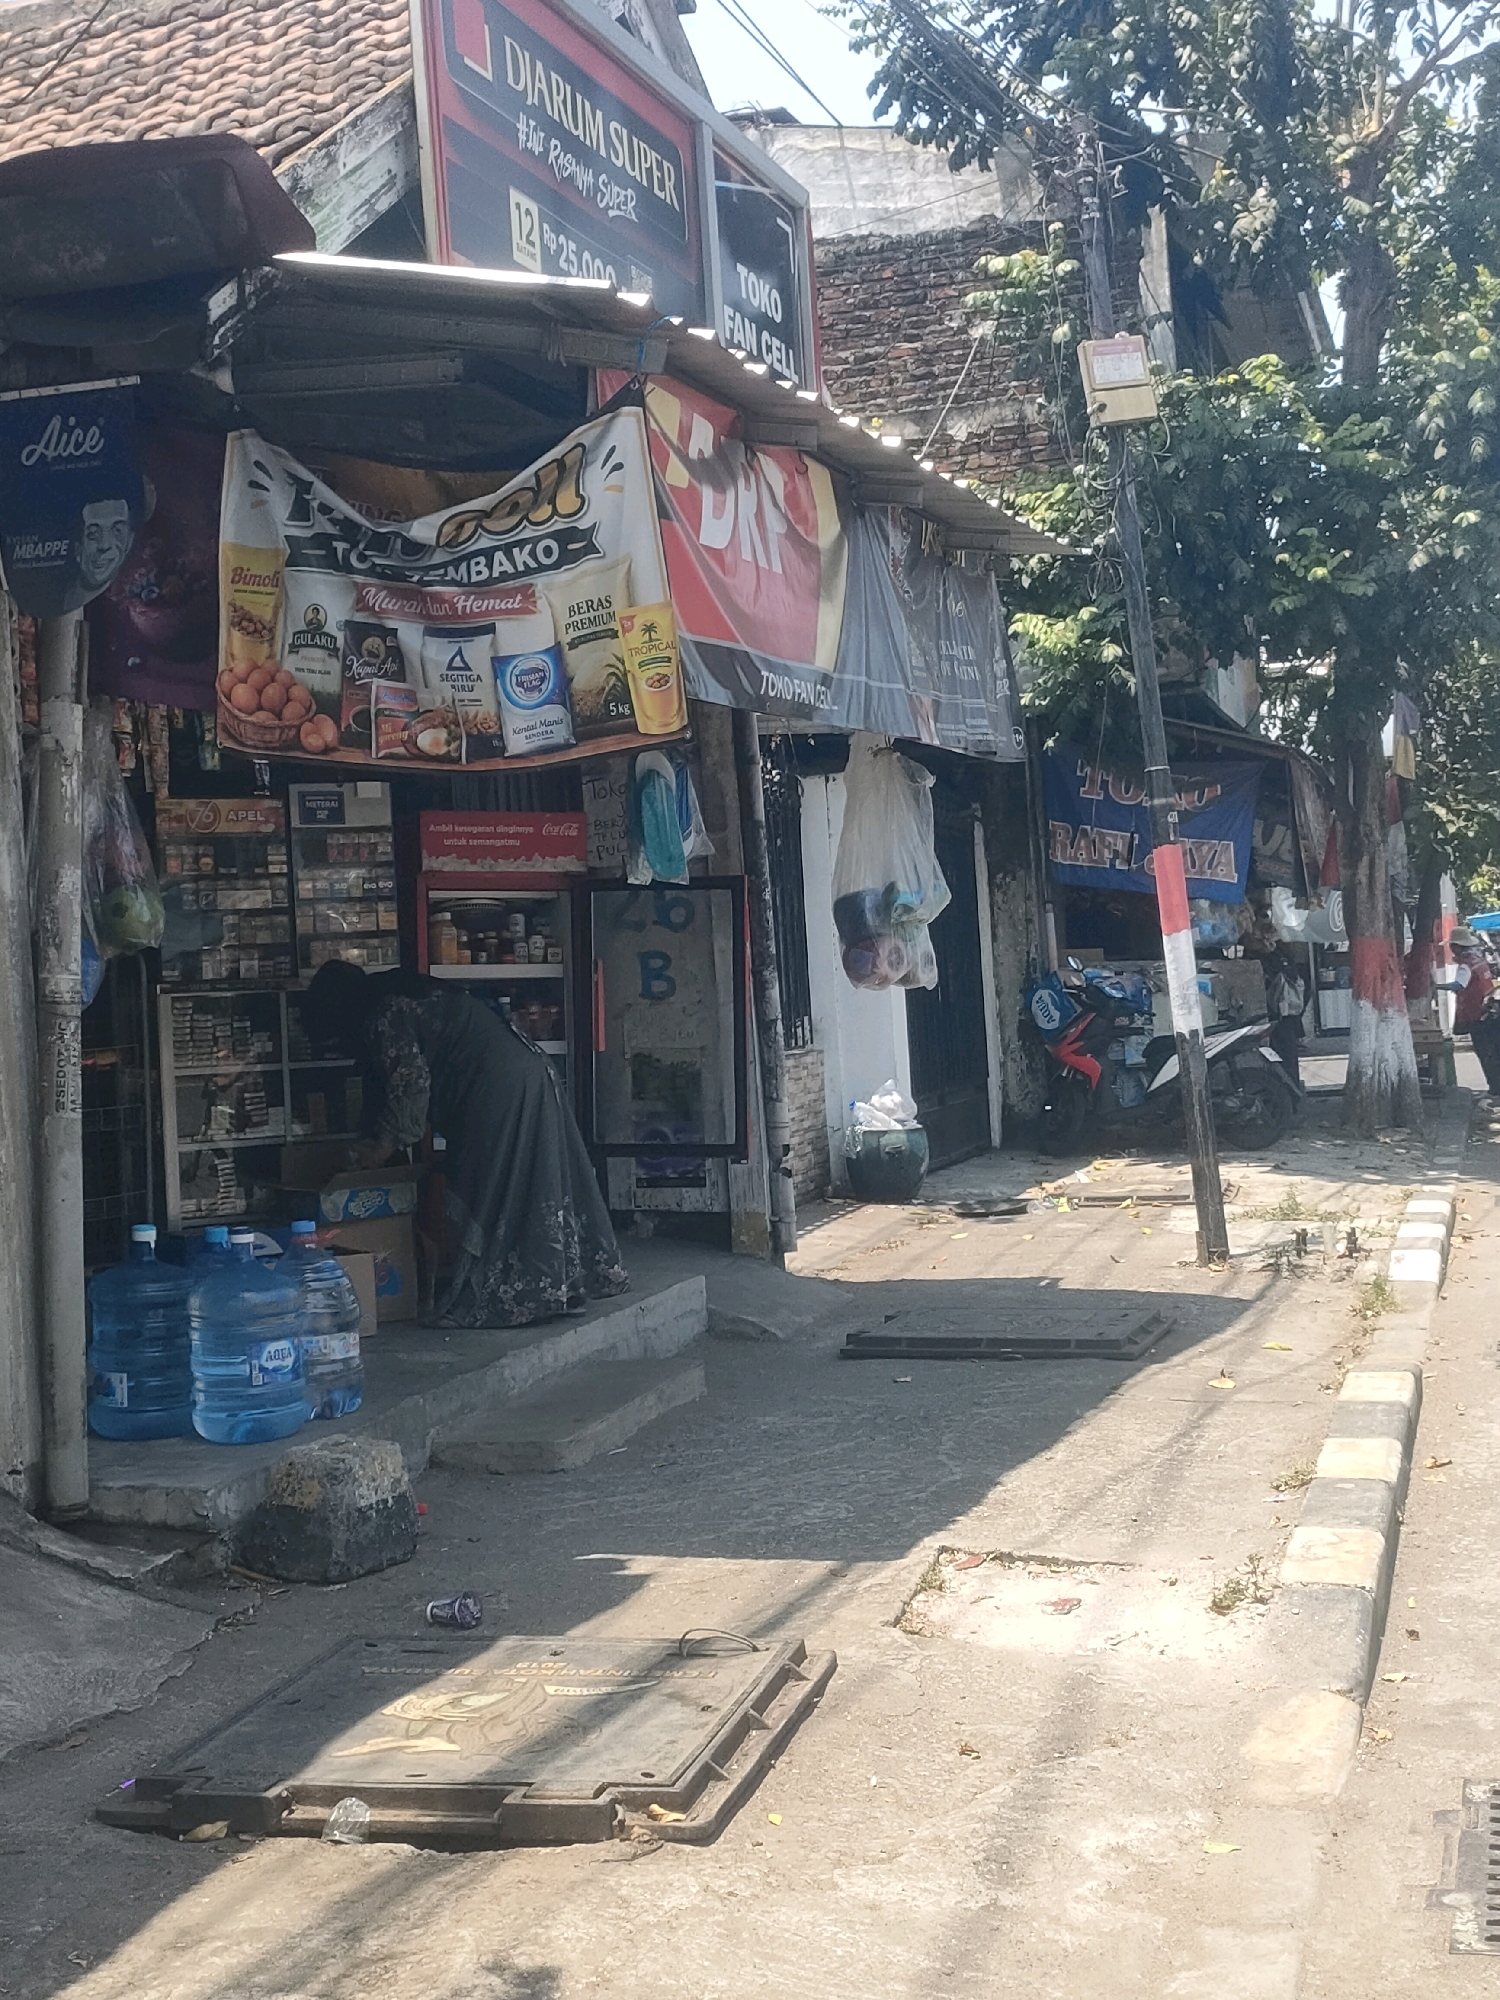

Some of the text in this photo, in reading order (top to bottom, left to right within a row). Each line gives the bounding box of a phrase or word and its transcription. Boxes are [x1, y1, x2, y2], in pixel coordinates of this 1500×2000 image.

[503, 35, 680, 213] DJARUM SUPER
[597, 174, 638, 222] SUPER
[515, 202, 536, 249] 12
[543, 223, 557, 255] Rp
[736, 262, 782, 324] TOKO
[724, 304, 799, 384] FAN CELL
[21, 414, 105, 466] Aice
[13, 540, 70, 560] MBAPPE
[231, 567, 280, 589] Bimoli
[362, 587, 523, 616] Murah dan Hemat
[568, 595, 612, 618] BERAS
[565, 610, 616, 635] PREMIUM
[294, 631, 335, 649] GULAKU
[628, 641, 677, 658] TROPICAL
[439, 673, 483, 683] SEGITIGA
[518, 671, 545, 683] FRISIAN
[523, 679, 541, 690] FLAG
[793, 679, 814, 706] FAN
[609, 702, 631, 716] 5 kg
[511, 717, 565, 736] Kental Manis
[524, 729, 555, 741] BENDERA
[227, 811, 266, 822] APEL
[429, 824, 534, 834] Ambil kesegaran dinginnya
[444, 838, 521, 847] untuk semangatmu
[1049, 821, 1138, 871] RAFI
[637, 950, 677, 1001] B
[1036, 994, 1056, 1024] AQUA
[56, 1048, 67, 1099] SEDOT
[265, 1346, 292, 1363] AQUA
